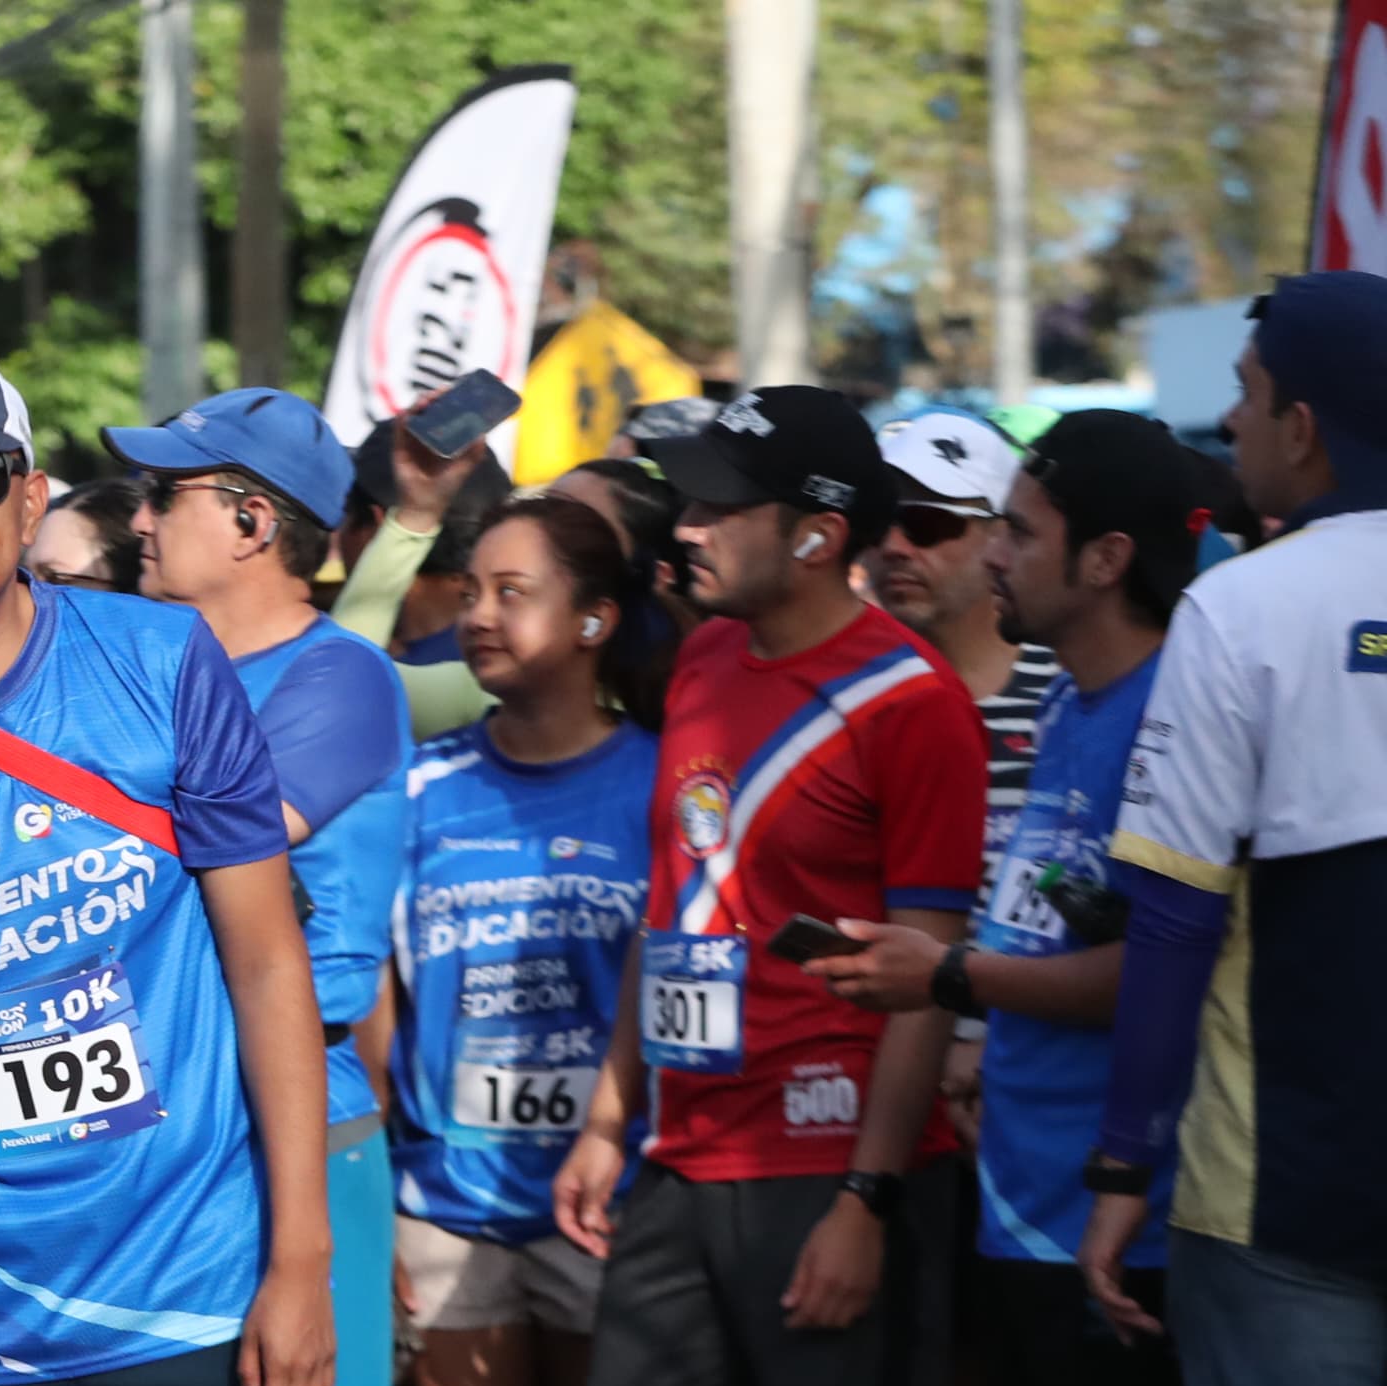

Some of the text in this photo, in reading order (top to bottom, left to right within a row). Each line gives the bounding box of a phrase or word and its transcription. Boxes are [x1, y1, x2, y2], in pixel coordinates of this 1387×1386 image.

[40, 970, 122, 1032] 10K
[653, 986, 709, 1042] 301
[544, 1026, 595, 1062] 5K
[484, 1076, 576, 1125] 166
